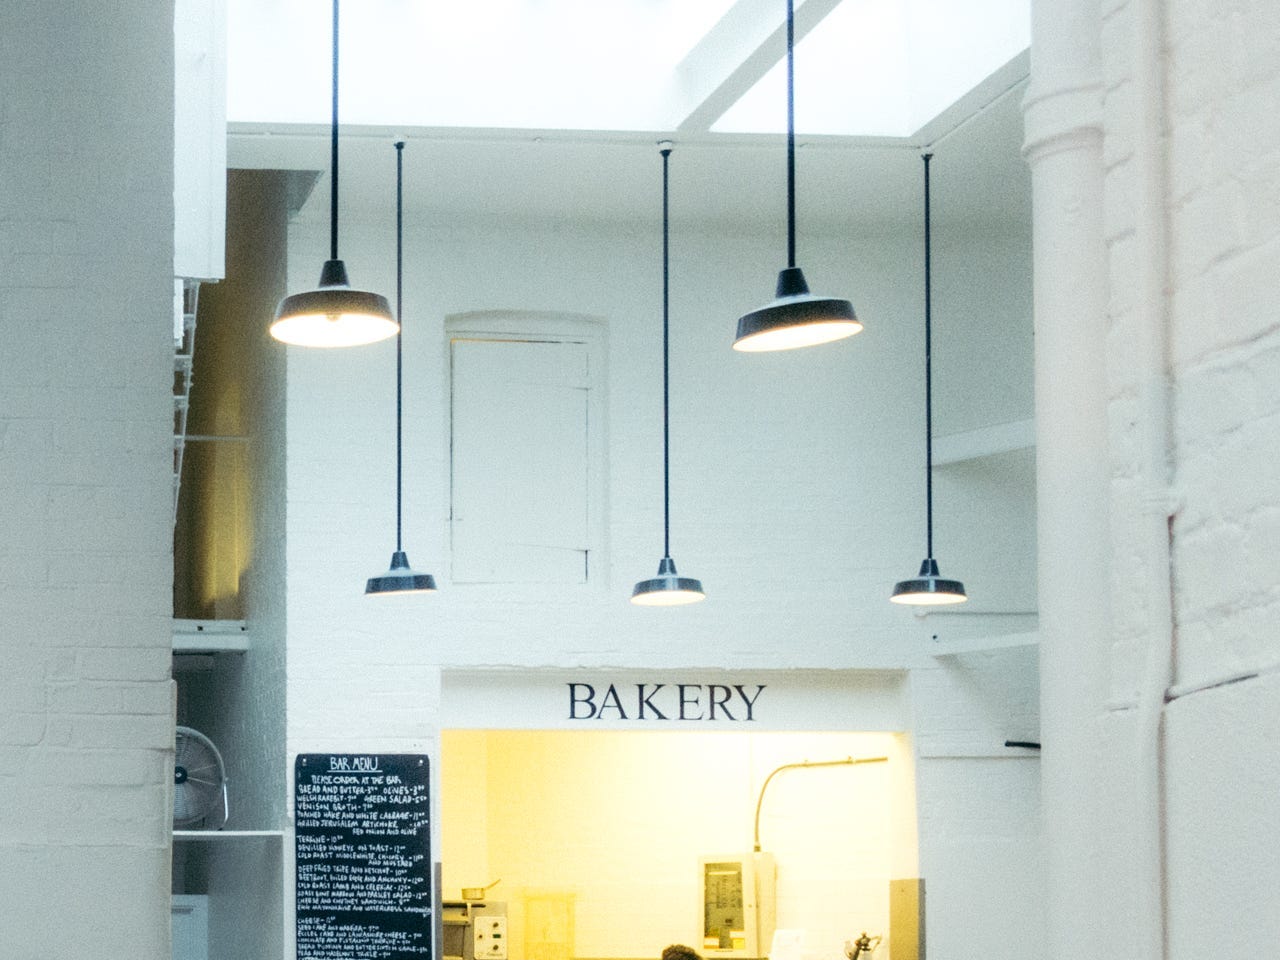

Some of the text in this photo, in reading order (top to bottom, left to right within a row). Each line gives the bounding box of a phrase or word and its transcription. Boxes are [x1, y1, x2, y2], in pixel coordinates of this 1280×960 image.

[566, 683, 767, 721] BAKERY
[330, 757, 378, 770] BAR MENU
[311, 776, 332, 785] PLEASE
[333, 776, 360, 785] ORDER
[386, 776, 402, 785] BAR
[298, 785, 321, 795] BREAD
[322, 785, 338, 795] AND
[340, 785, 365, 795] BUTTER
[297, 795, 318, 803] WELSH
[364, 795, 387, 803] GREEN
[389, 796, 412, 804] SALAD
[297, 803, 329, 811] VENISON
[332, 803, 358, 811] BROTH
